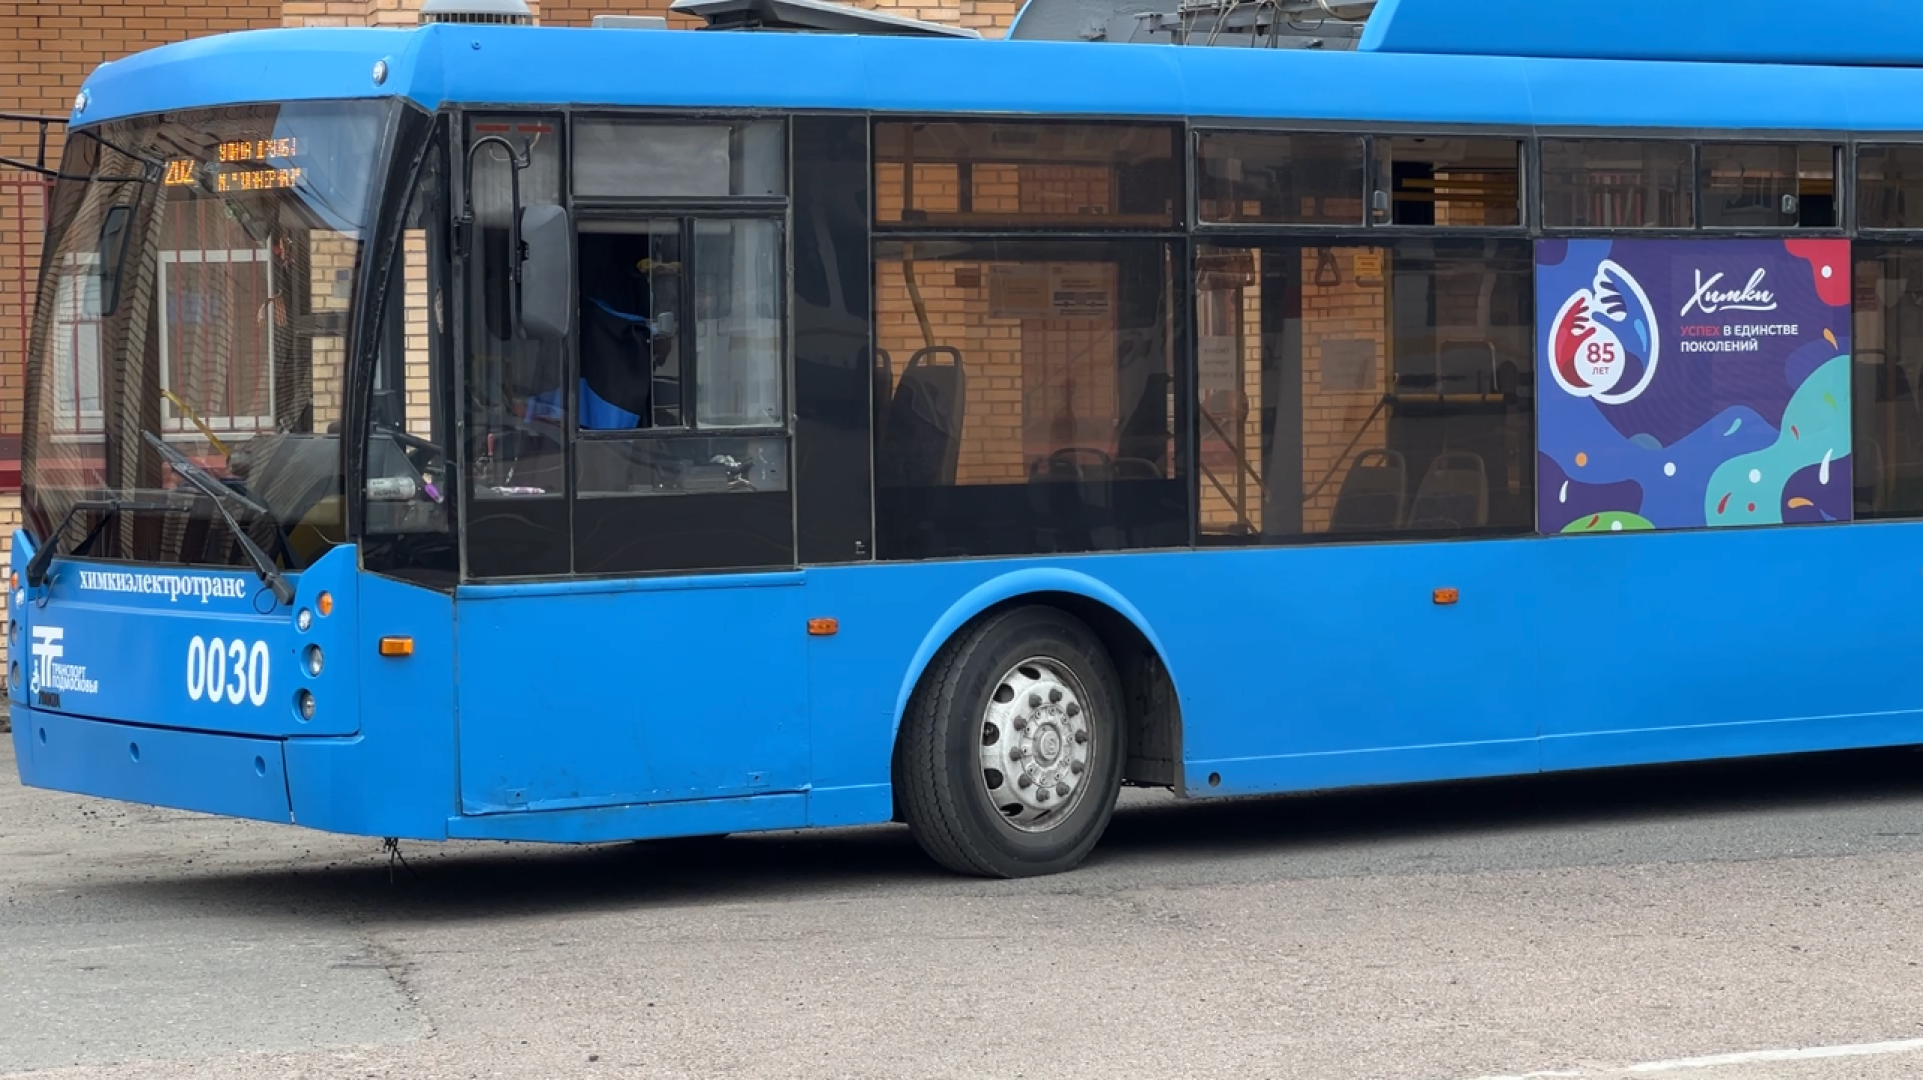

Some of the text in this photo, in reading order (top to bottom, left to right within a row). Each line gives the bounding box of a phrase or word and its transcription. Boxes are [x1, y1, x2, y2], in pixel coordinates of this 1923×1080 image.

[165, 160, 195, 184] 202
[1680, 267, 1777, 316] Химки
[1681, 324, 1799, 337] УСПЕХ В ЕДИНСТВЕ
[1587, 342, 1615, 363] 85
[1681, 338, 1759, 352] ПОКОЛЕНИЙ
[1592, 366, 1610, 375] ЛЕТ
[79, 570, 246, 603] химкиэлектротранс
[52, 662, 86, 679] ТРАНСПОРТ
[186, 635, 270, 706] 0030
